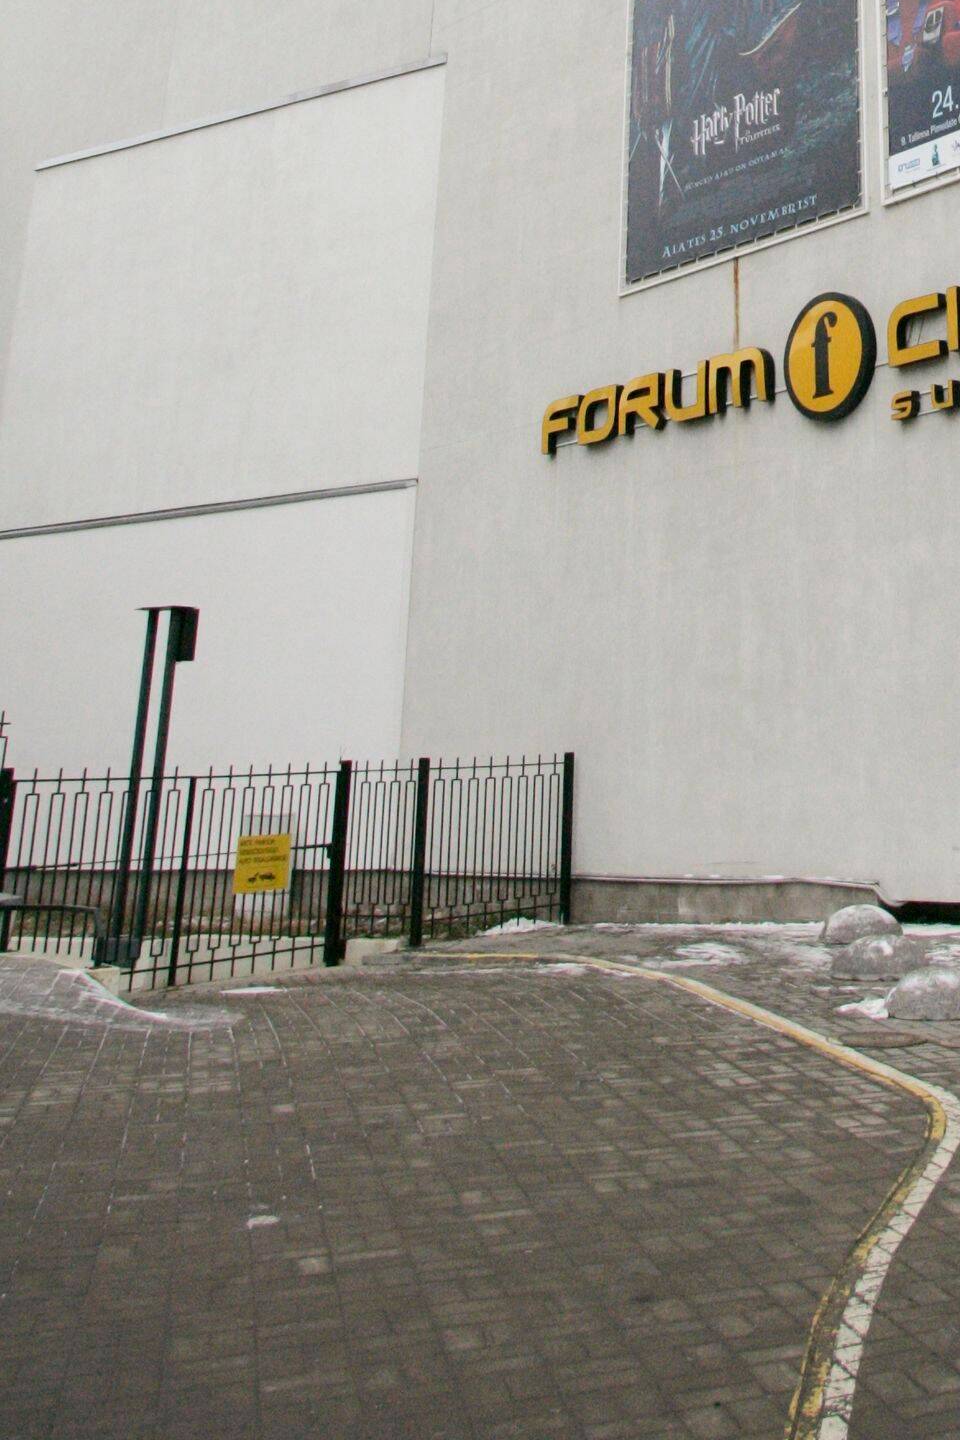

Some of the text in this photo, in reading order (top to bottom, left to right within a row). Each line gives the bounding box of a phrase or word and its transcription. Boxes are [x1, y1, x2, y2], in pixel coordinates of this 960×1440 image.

[691, 87, 781, 156] Harry Potter
[931, 85, 959, 119] 24.
[730, 194, 818, 235] NOVEMBRIST
[541, 346, 776, 456] FORUM
